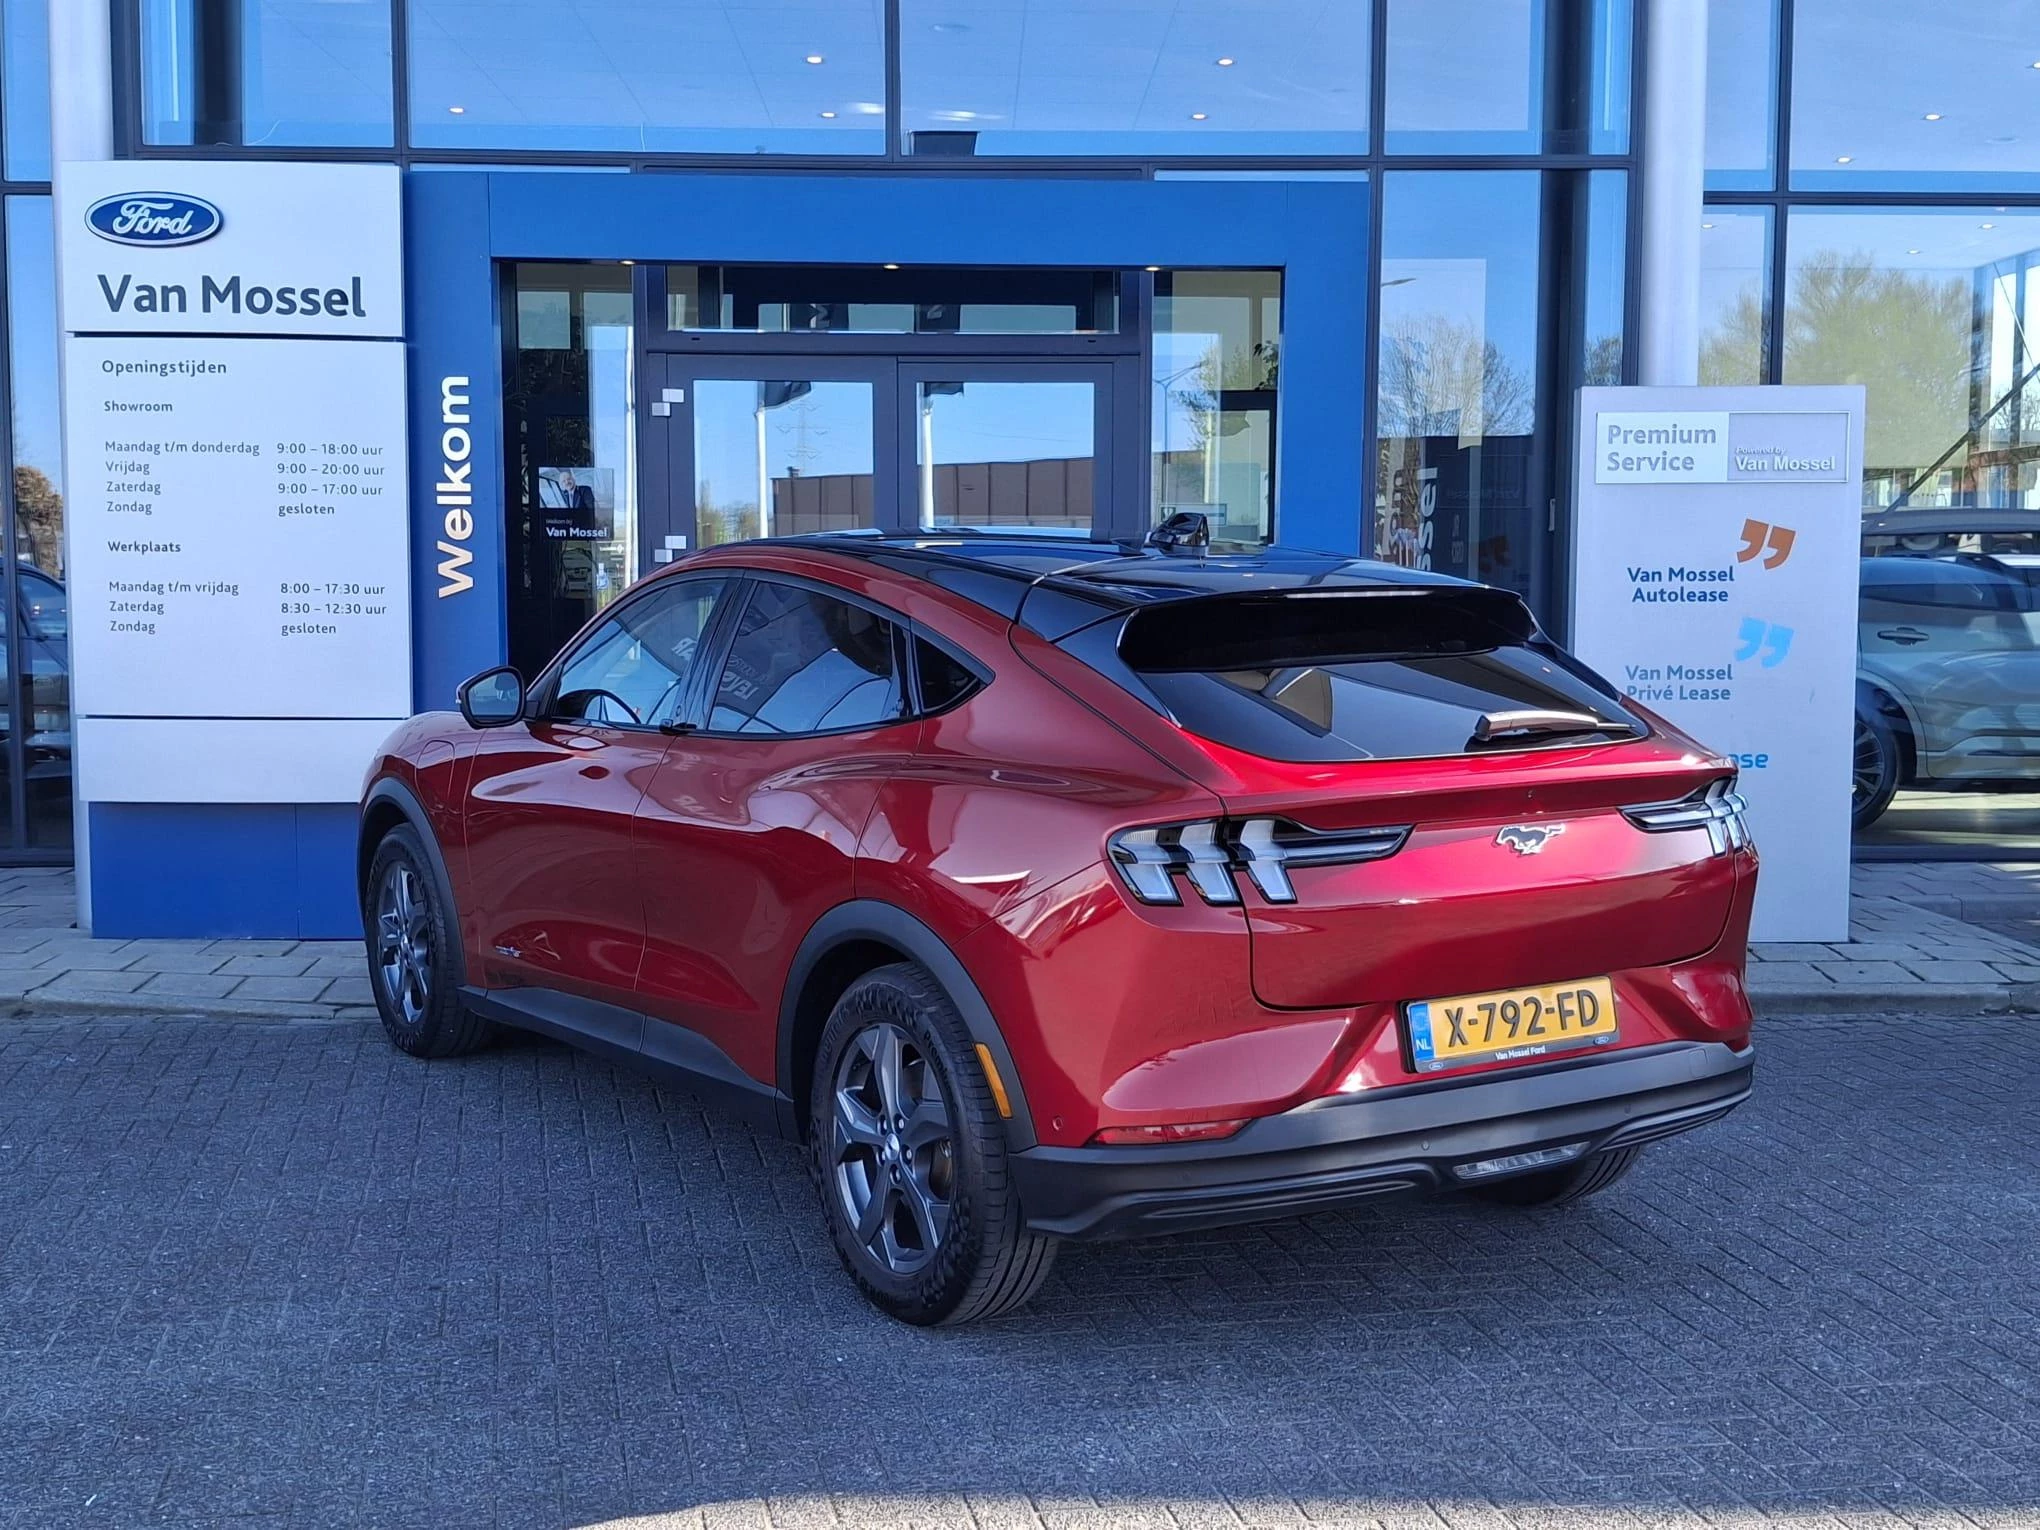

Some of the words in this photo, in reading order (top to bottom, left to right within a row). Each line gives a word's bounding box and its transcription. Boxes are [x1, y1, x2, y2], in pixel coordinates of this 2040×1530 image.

[112, 200, 193, 236] Ford
[97, 274, 186, 312] Van
[202, 275, 366, 317] Mossel
[102, 360, 226, 376] Openingstijden
[105, 400, 172, 411] Showroom
[1607, 424, 1717, 444] Premium
[106, 441, 160, 455] Maandag
[165, 442, 187, 452] t/m
[192, 441, 260, 456] donderdag
[277, 443, 306, 454] 9:00
[322, 444, 357, 454] 18:00
[106, 461, 150, 475] Vrijdag
[1607, 450, 1695, 472] Service
[1735, 457, 1768, 471] Van
[1773, 456, 1836, 472] Mossel
[277, 463, 306, 474] 9:00
[322, 464, 359, 475] 20:00
[107, 481, 161, 495] Zaterdag
[278, 483, 307, 494] 9:00
[323, 484, 357, 494] 17:00
[436, 376, 474, 599] Welkom
[107, 501, 152, 515] Zondag
[279, 503, 334, 517] gesloten
[1417, 467, 1438, 572] ssel
[546, 527, 566, 537] Van
[569, 527, 608, 537] Mossel
[108, 541, 180, 555] Werkplaats
[1627, 567, 1662, 582] Van
[1668, 565, 1735, 582] Mossel
[109, 581, 164, 595] Maandag
[169, 581, 191, 592] t/m
[195, 582, 239, 596] vrijdag
[281, 583, 309, 593] 8:00
[325, 584, 359, 594] 17:30
[1632, 586, 1729, 603] Autolease
[110, 601, 164, 615] Zaterdag
[281, 603, 310, 613] 8:30
[325, 603, 361, 614] 12:30
[111, 620, 155, 634] Zondag
[282, 622, 336, 636] gesloten
[1625, 665, 1661, 681] Van
[1666, 663, 1733, 681] Mossel
[1626, 684, 1673, 700] Privé
[1680, 684, 1731, 700] Lease
[1444, 989, 1599, 1047] X-792-FD
[1415, 1039, 1431, 1050] NL
[1495, 1051, 1508, 1060] Van
[1508, 1047, 1530, 1058] Mossel
[1531, 1045, 1546, 1055] Ford
